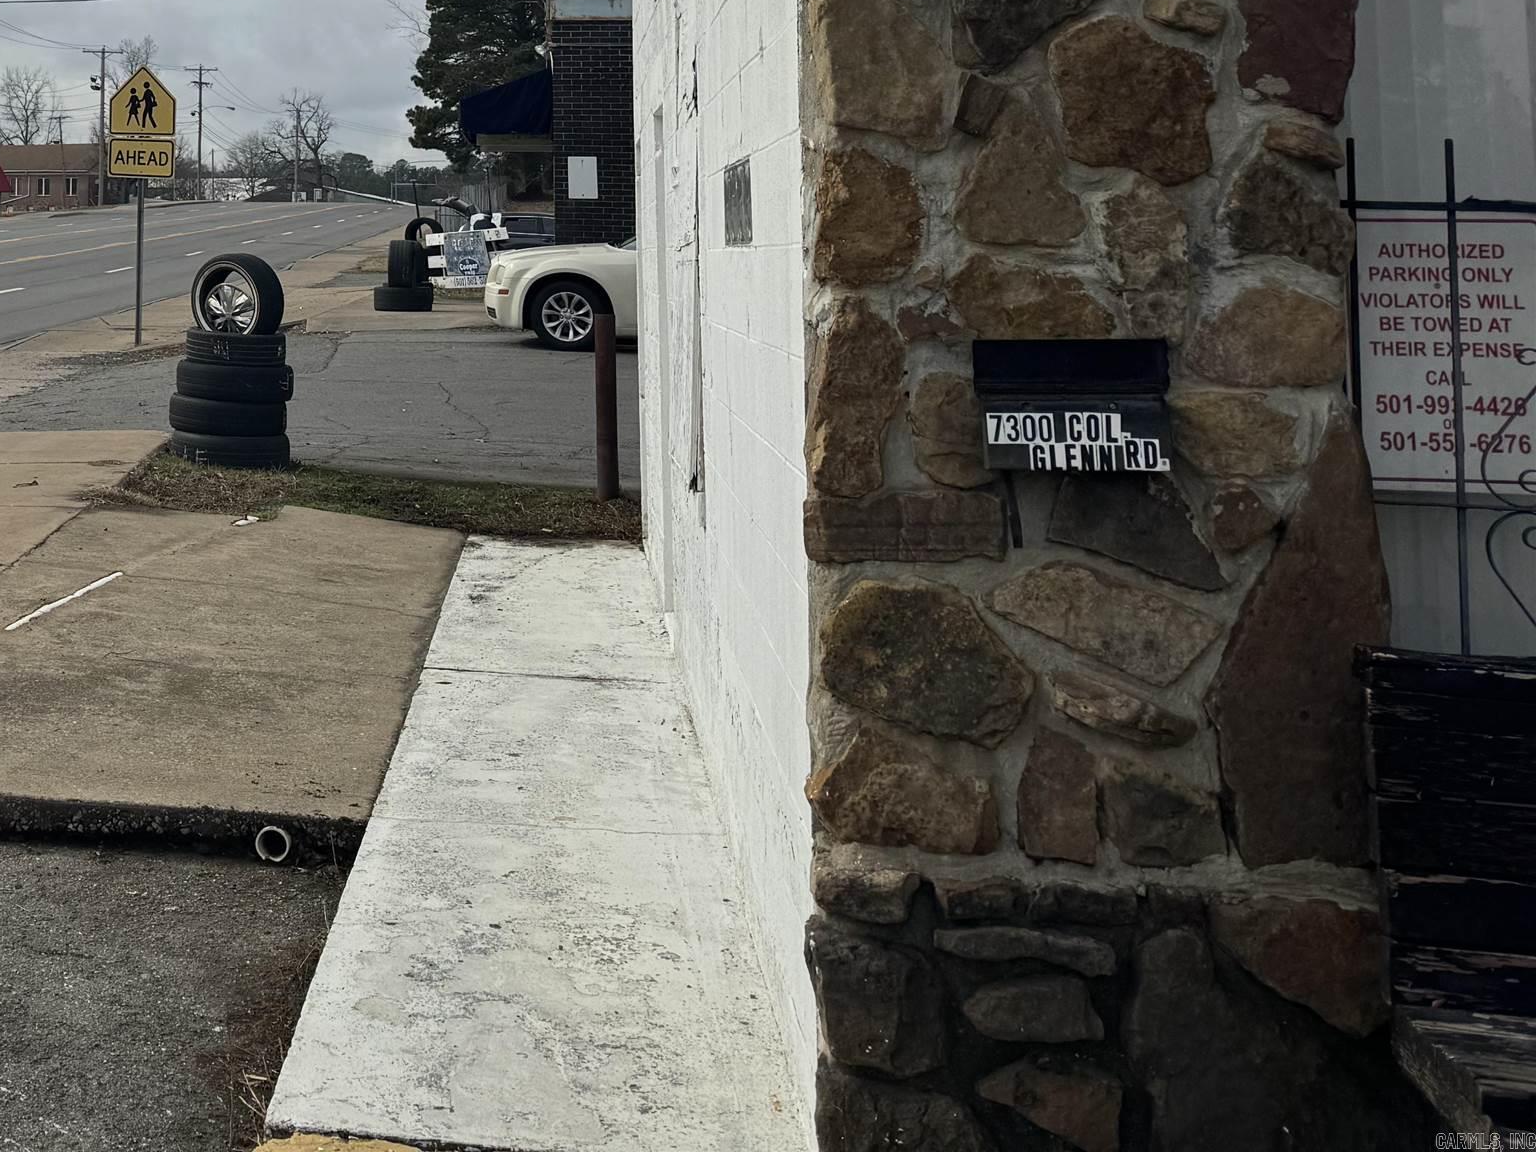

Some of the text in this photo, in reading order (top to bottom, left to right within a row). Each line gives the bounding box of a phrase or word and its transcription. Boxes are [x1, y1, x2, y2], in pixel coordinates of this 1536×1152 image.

[114, 150, 169, 166] AHEAD
[1462, 267, 1513, 283] ONLY
[1477, 294, 1526, 310] WILL
[1379, 316, 1405, 332] BE
[1488, 317, 1512, 333] AT
[1369, 341, 1427, 357] THEIR
[1375, 394, 1528, 417] 501-99-4426
[989, 414, 1053, 443] 7300
[1380, 431, 1532, 455] 501-55-6276
[1032, 444, 1114, 471] GLENN
